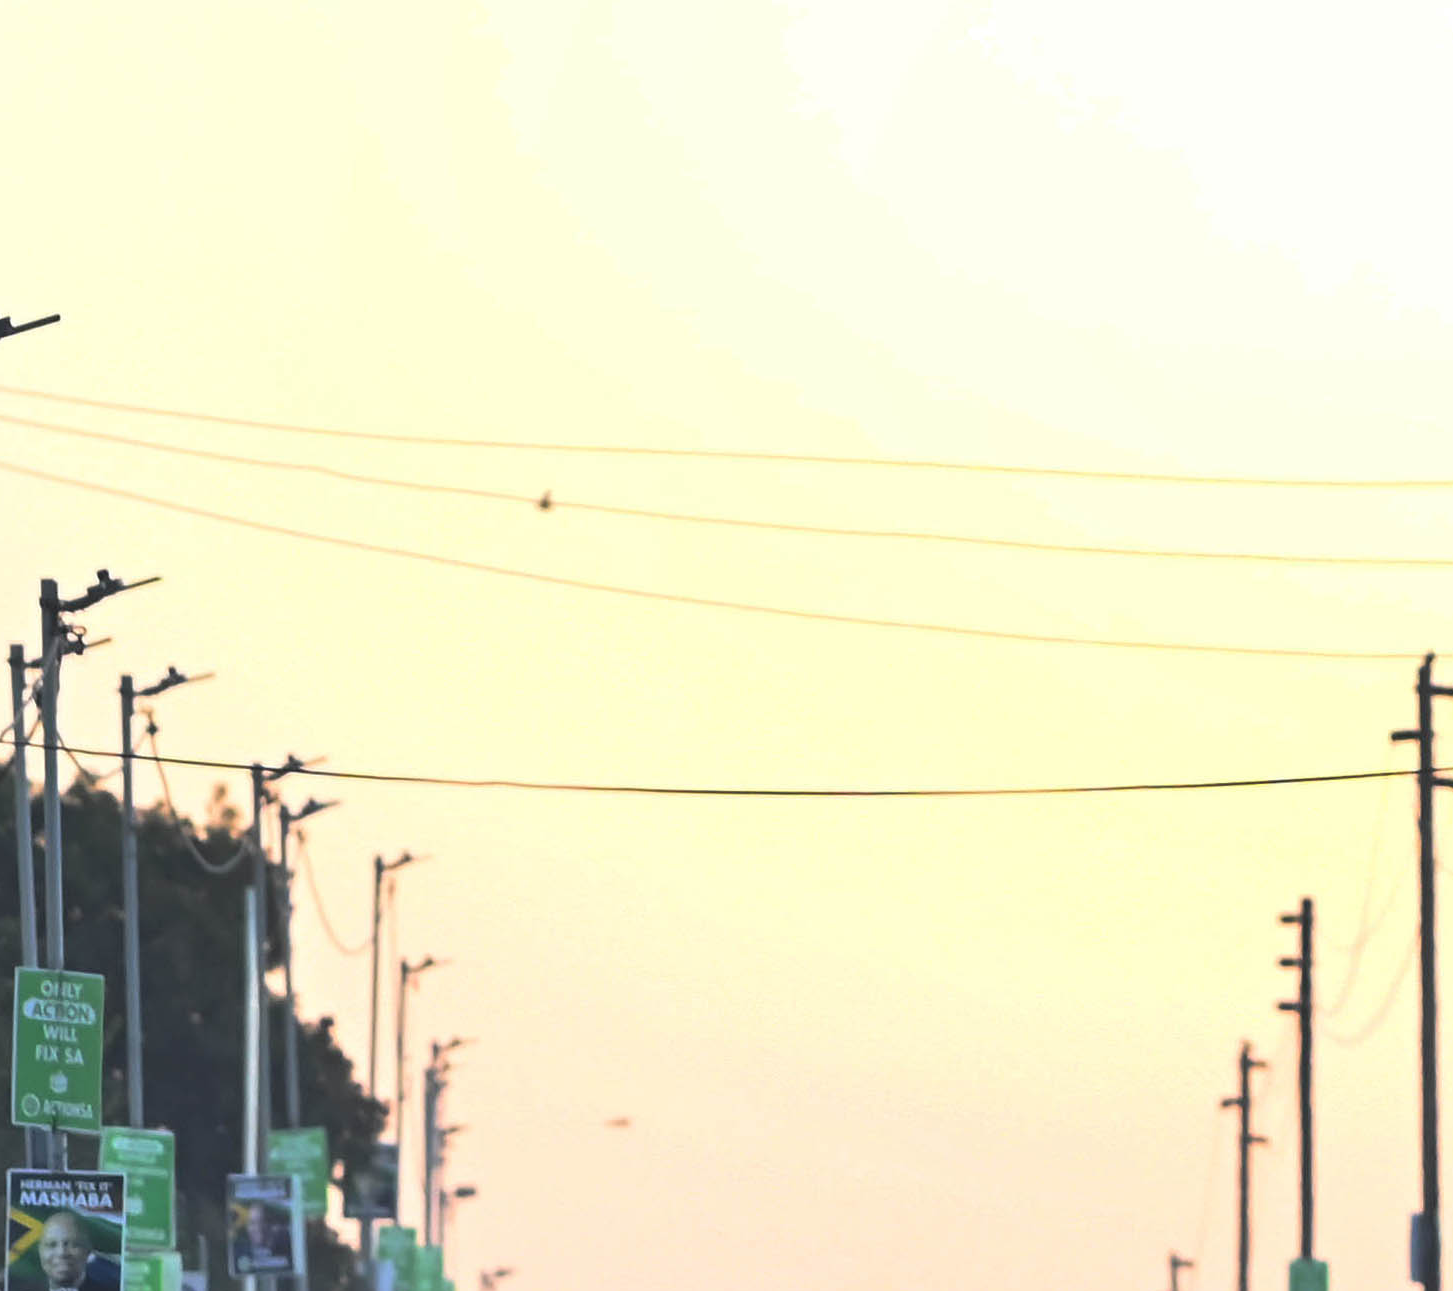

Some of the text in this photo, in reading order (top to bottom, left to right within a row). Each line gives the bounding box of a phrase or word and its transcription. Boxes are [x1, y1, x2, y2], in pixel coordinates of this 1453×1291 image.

[40, 980, 83, 999] ONLY
[32, 1003, 90, 1022] ACTION
[43, 1024, 78, 1042] WILL
[36, 1045, 84, 1066] FIX SA
[20, 1180, 71, 1191] HERMAN
[20, 1191, 112, 1208] MASHABA
